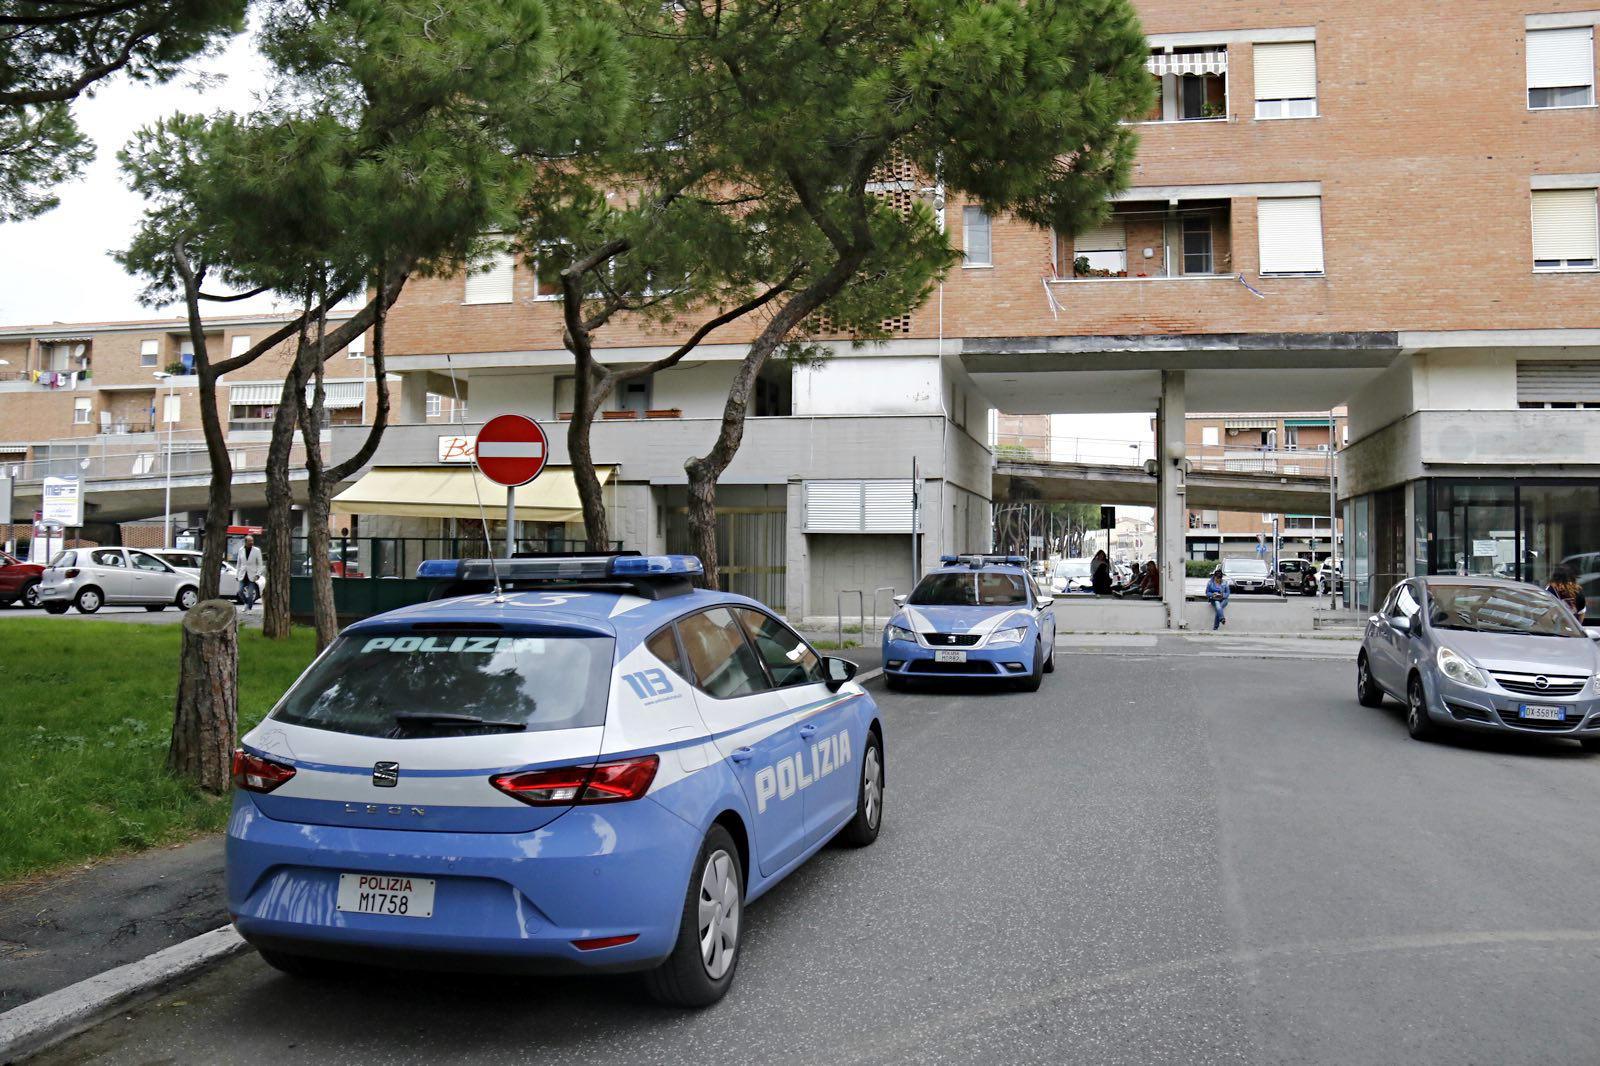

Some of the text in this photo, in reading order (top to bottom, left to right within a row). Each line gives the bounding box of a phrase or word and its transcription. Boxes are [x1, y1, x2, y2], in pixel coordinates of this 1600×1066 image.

[361, 637, 545, 654] POLIZIA
[621, 668, 674, 699] 113
[755, 729, 852, 815] POLIZIA
[345, 803, 426, 816] LEON
[359, 876, 413, 893] POLIZIA
[359, 893, 409, 915] M1758
